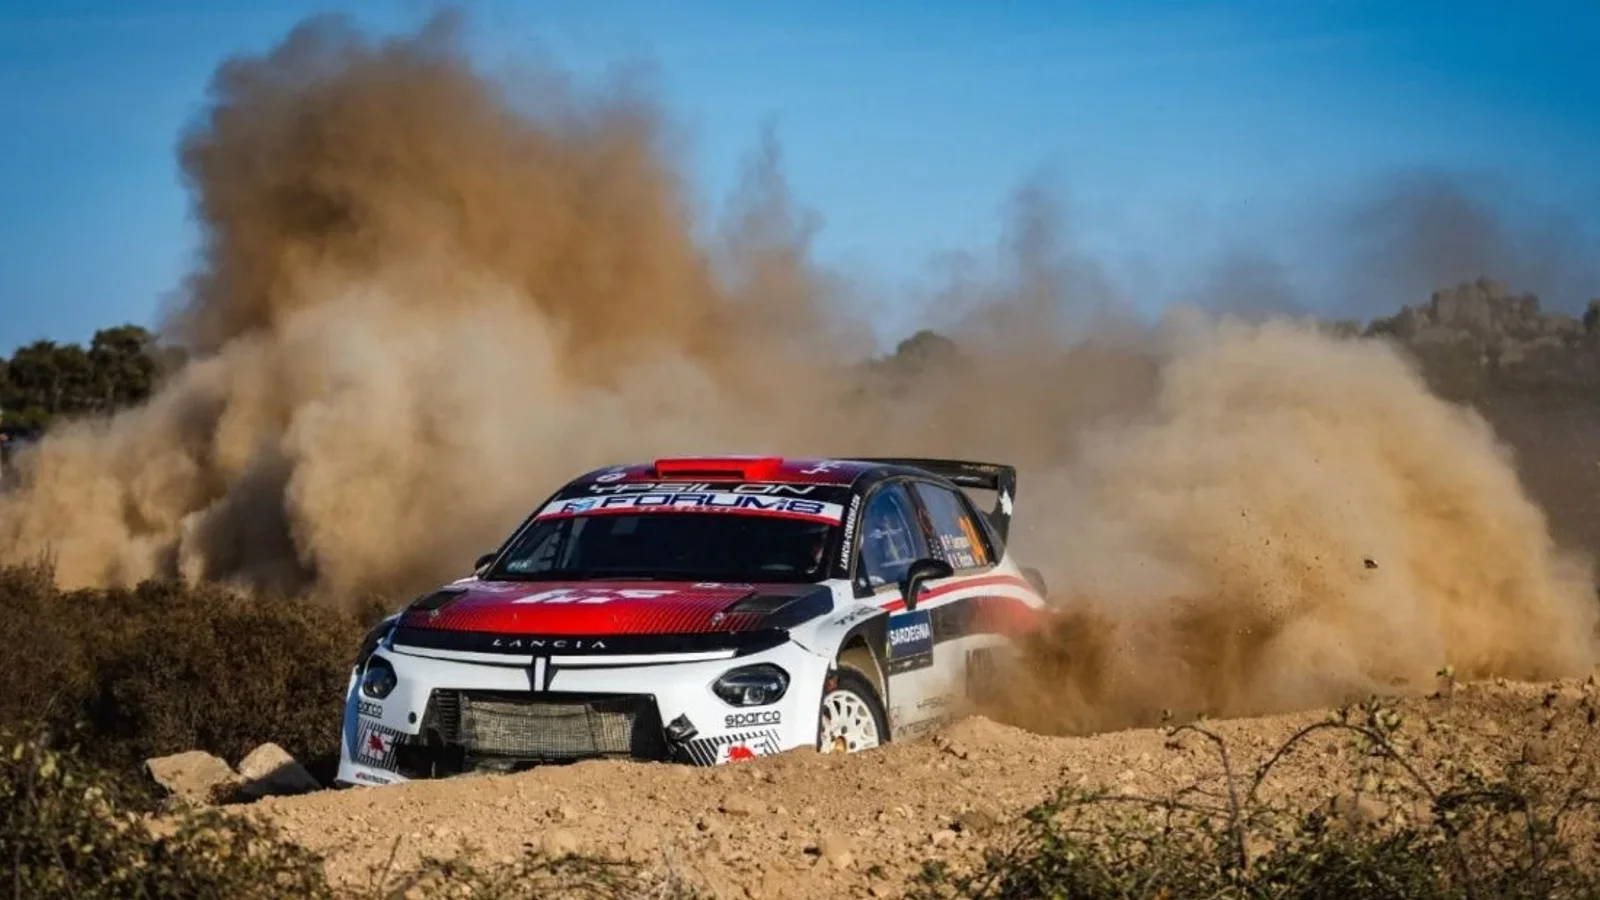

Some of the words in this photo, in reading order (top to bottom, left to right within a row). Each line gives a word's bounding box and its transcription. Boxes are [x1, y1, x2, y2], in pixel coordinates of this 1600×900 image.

[589, 483, 817, 495] YPSILON
[601, 494, 825, 514] FORUM8
[492, 638, 606, 649] LANCIA
[889, 623, 930, 646] SARDEGNA
[725, 710, 781, 729] sparco
